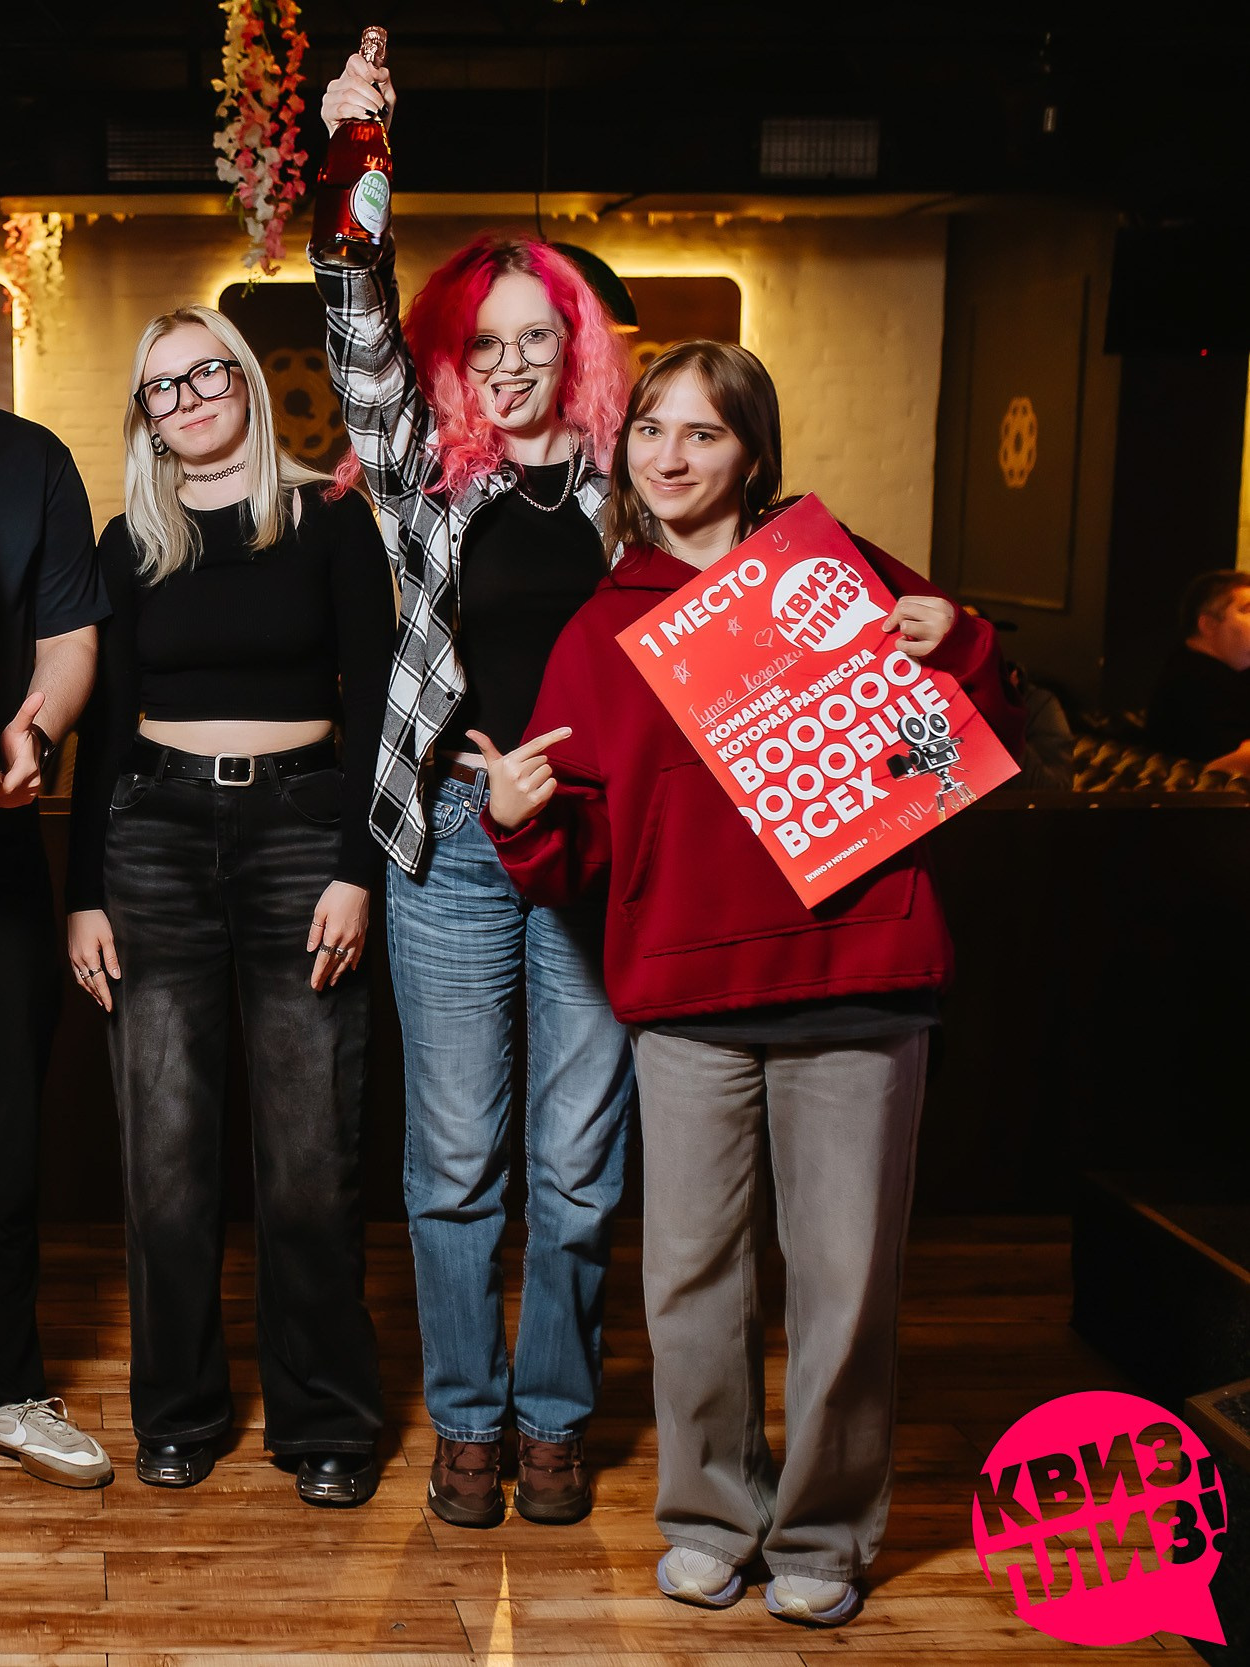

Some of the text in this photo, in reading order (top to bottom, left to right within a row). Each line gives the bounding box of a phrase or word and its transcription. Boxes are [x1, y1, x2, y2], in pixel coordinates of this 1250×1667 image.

[639, 558, 768, 658] 1 МЕСТО
[705, 685, 792, 747] КОМАНДЕ,
[717, 648, 877, 762] КОТОРАЯ РАЗНЕСЛА
[728, 650, 922, 795] ВООООО
[773, 766, 891, 859] ВСЕХ
